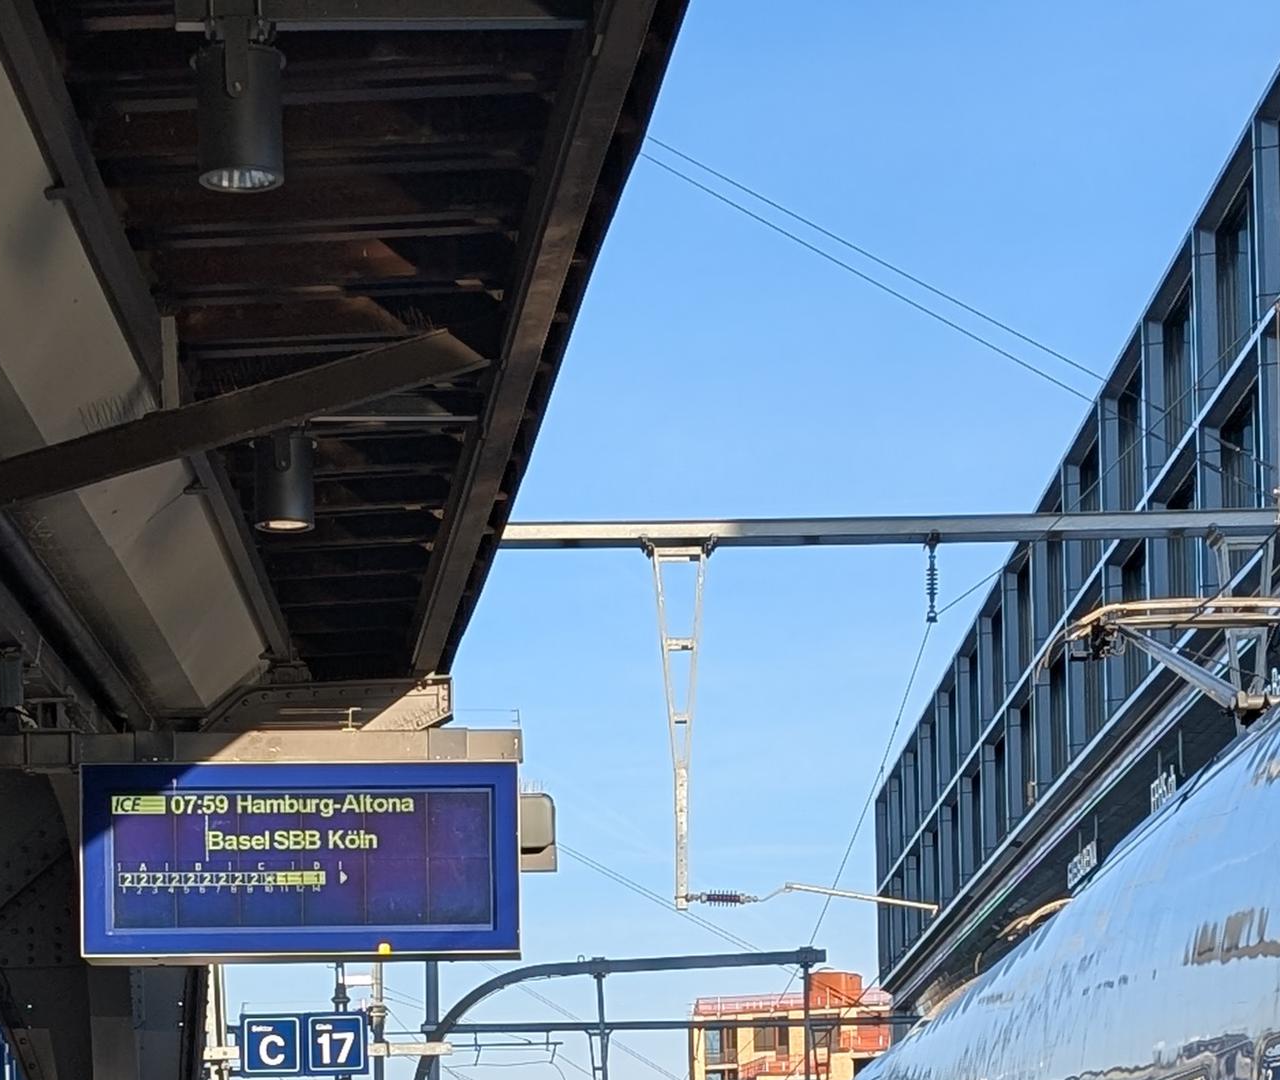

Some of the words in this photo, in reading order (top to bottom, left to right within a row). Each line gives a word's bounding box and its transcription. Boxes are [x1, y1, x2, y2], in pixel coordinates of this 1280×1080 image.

[114, 797, 141, 813] ICE
[171, 795, 228, 815] 07:59
[237, 794, 414, 817] Hamburg-Altona
[208, 830, 270, 851] Basel
[273, 830, 321, 850] SBB
[328, 829, 378, 849] Köln
[259, 1034, 285, 1066] C
[317, 1032, 355, 1064] 17
